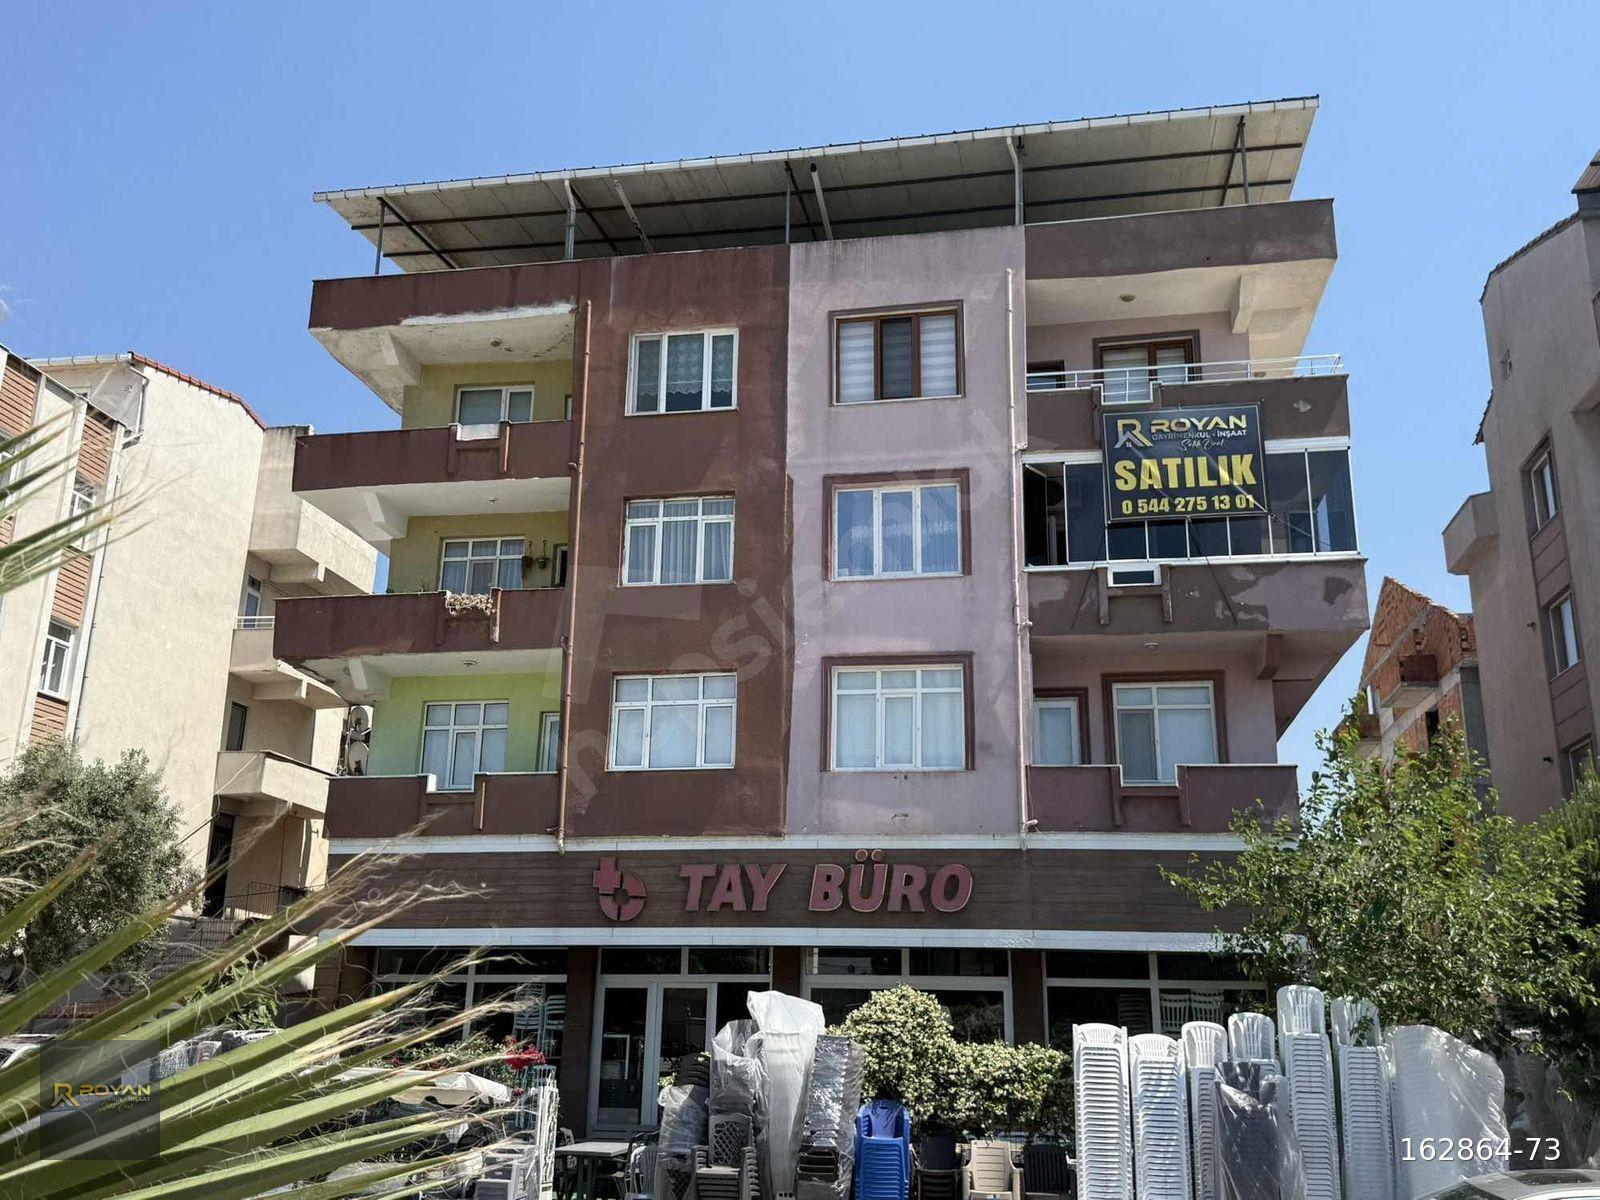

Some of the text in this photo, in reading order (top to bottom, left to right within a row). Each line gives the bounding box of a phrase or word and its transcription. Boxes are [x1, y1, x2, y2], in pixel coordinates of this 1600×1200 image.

[1150, 414, 1247, 433] ROYAN
[1216, 429, 1247, 439] İNŞAAT
[1114, 453, 1257, 491] SATILIK
[1121, 493, 1255, 515] 0 544 275 13 01
[679, 849, 973, 914] TAY BÜRO
